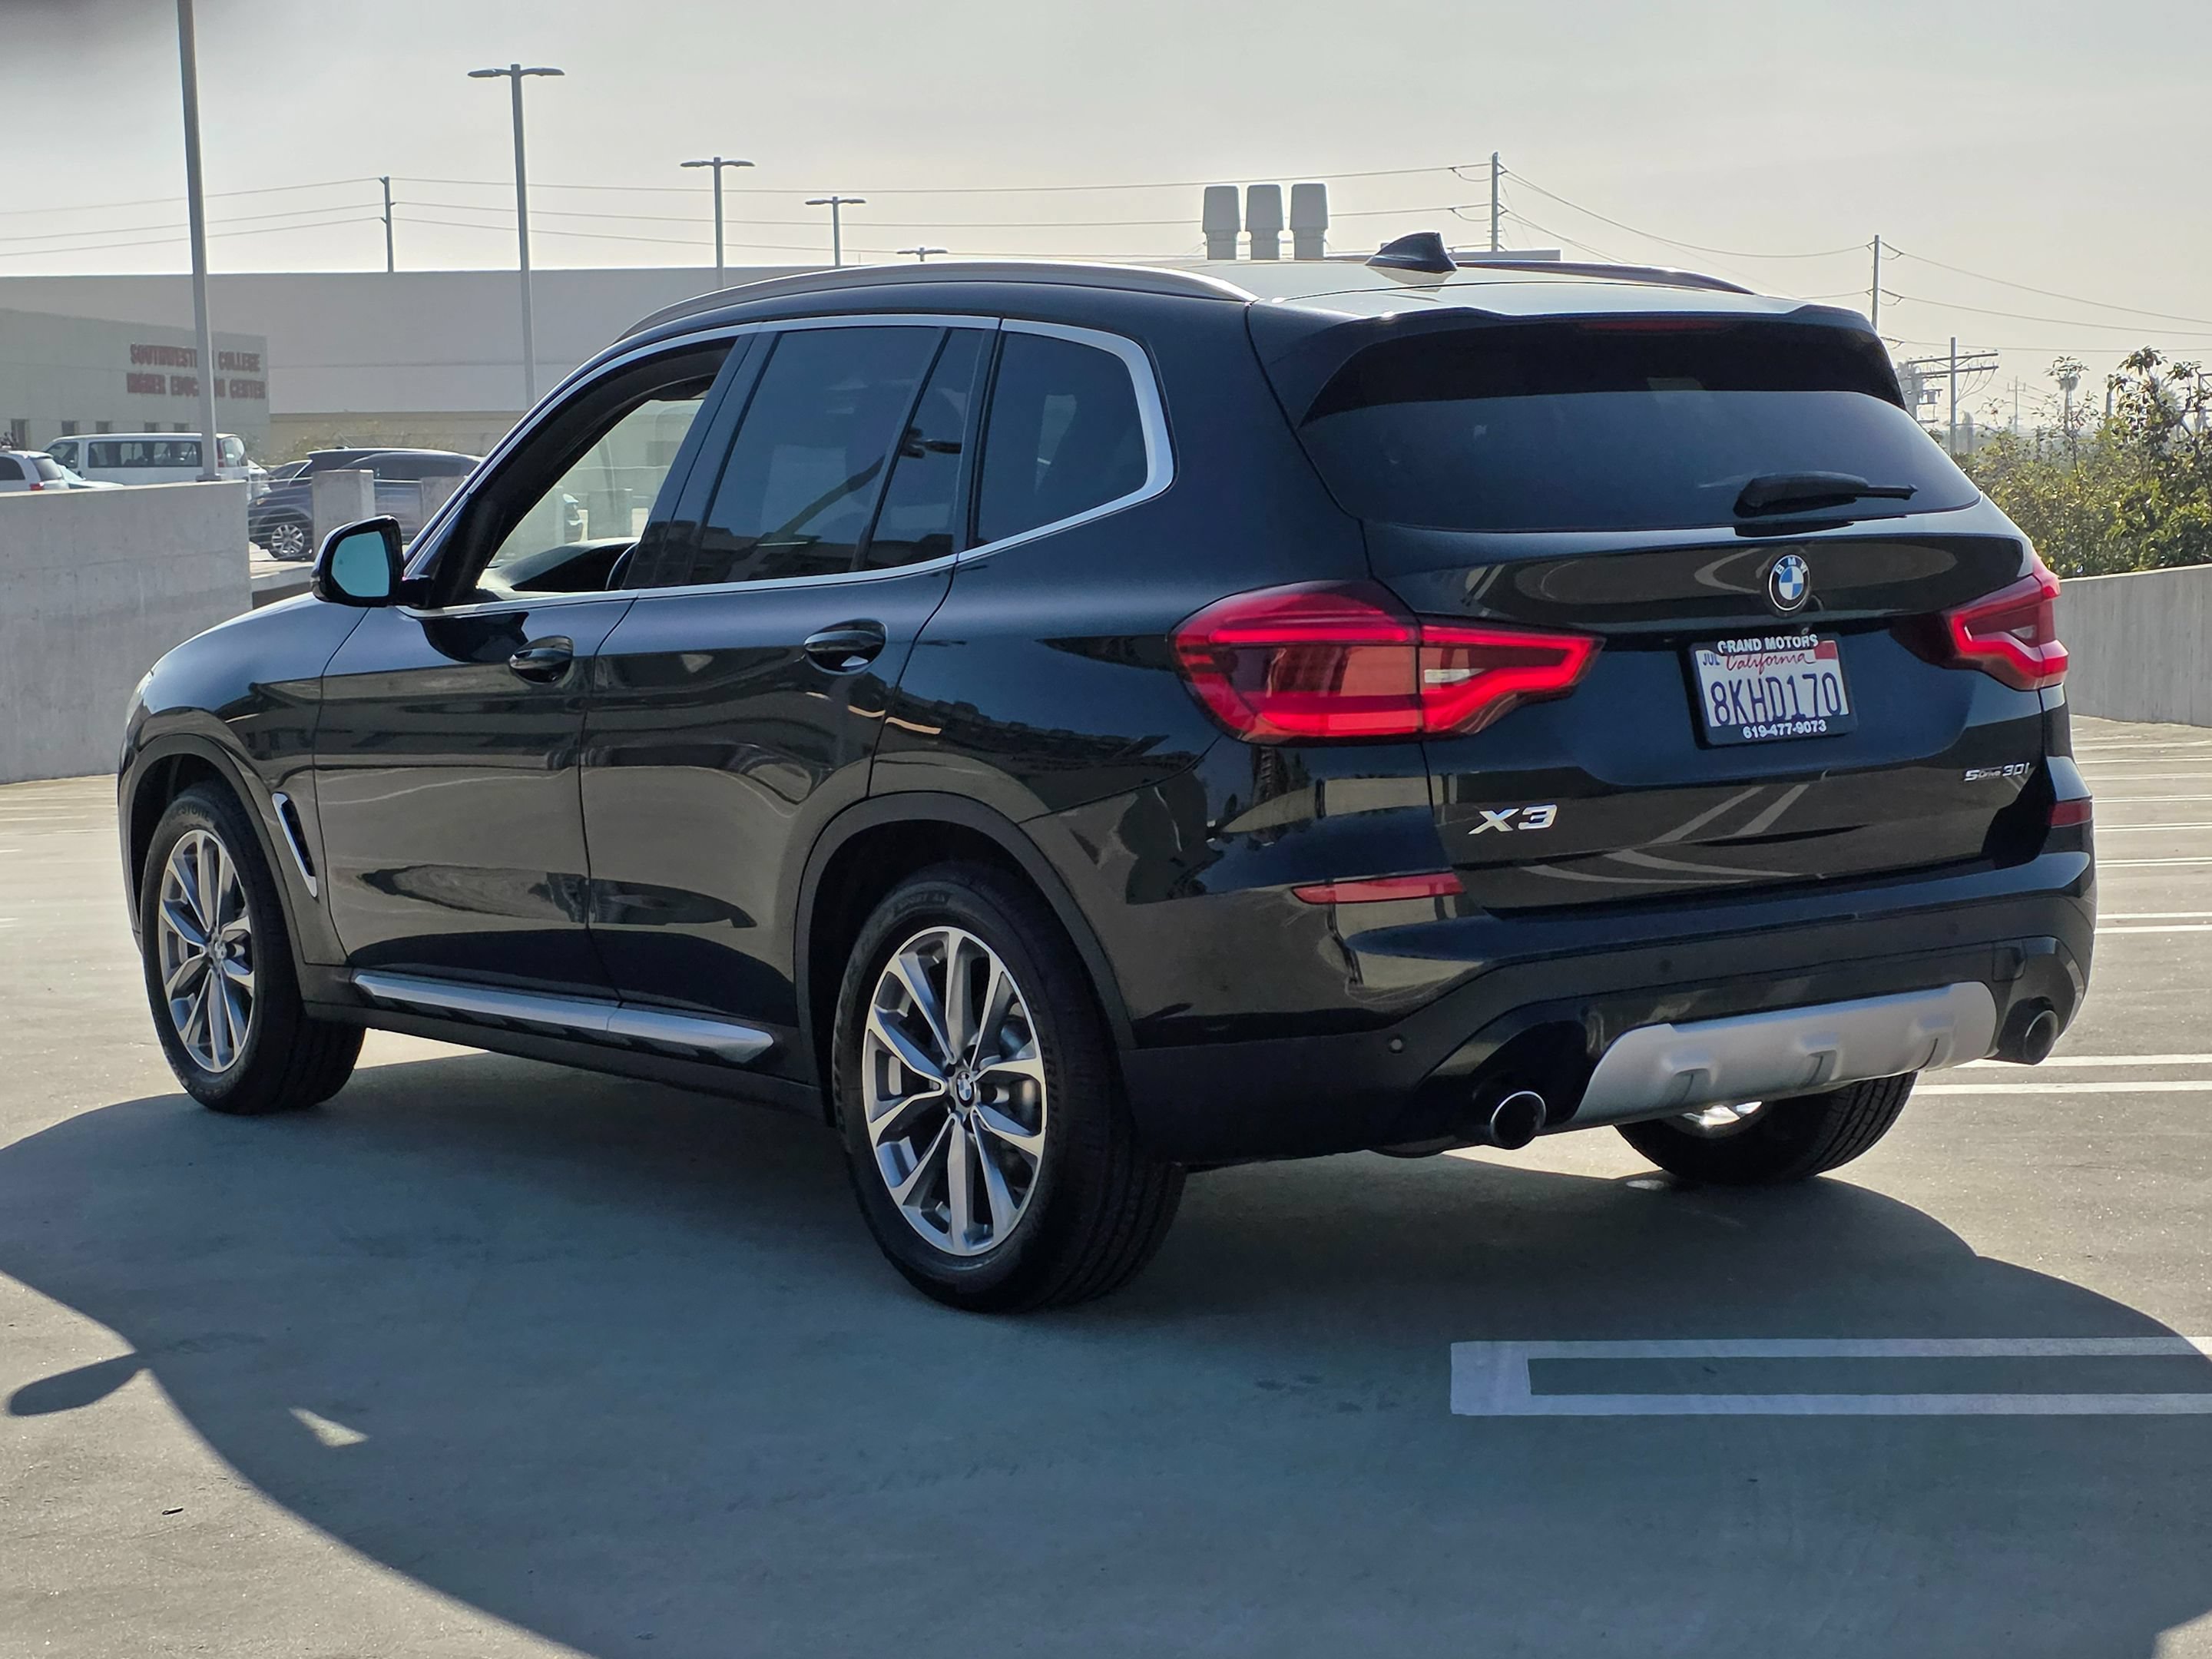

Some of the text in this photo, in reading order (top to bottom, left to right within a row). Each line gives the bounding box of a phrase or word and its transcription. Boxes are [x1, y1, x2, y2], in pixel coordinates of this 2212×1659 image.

[130, 343, 260, 372] SOUTHWEST COLLEGE
[126, 373, 266, 400] HIGHER EDUCON CENTER
[1775, 557, 1809, 575] BMW
[1717, 634, 1819, 654] GRAND MOTORS
[1702, 652, 1816, 674] JUL California
[1710, 672, 1842, 727] 8KHD170
[1743, 720, 1827, 740] 619-477-9073
[1468, 804, 1558, 835] X3
